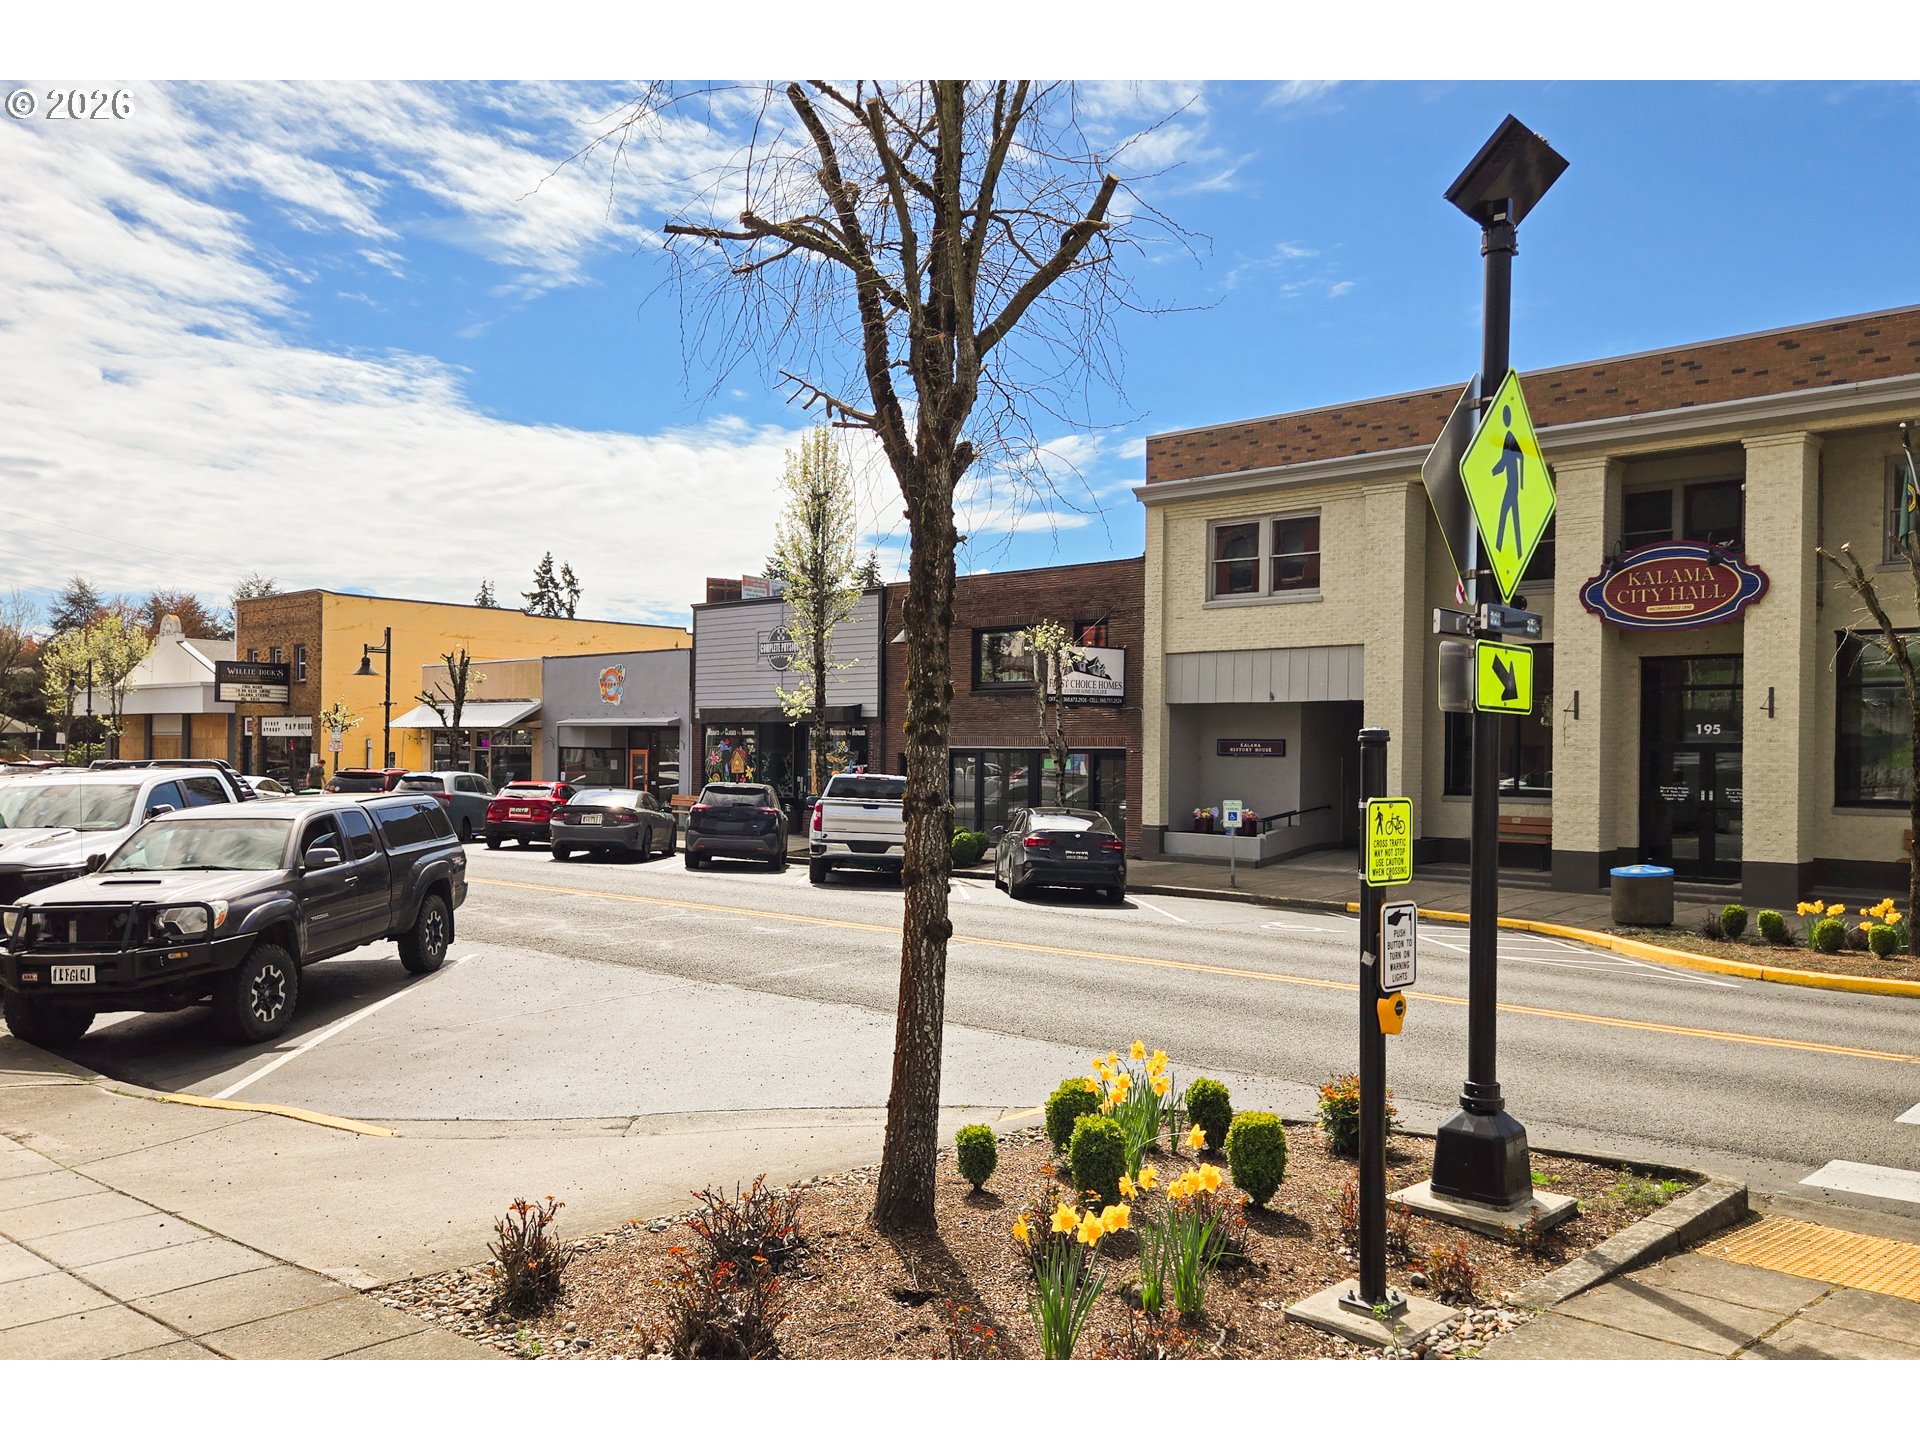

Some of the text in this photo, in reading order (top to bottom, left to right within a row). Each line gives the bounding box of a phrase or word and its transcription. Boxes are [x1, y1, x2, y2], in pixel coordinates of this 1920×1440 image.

[1628, 567, 1715, 587] KALAMA
[1617, 583, 1726, 604] CITY HALL
[1648, 604, 1682, 612] INCORPORATED
[760, 643, 781, 653] COMPLETE
[227, 667, 256, 675] WILLIE
[1070, 680, 1098, 690] CHOICE
[1098, 681, 1123, 691] HOMES
[1695, 724, 1721, 735] 195
[1374, 838, 1407, 848] CROSS TRAFFIC
[1374, 848, 1406, 857] MAY NOT STOP
[1376, 858, 1404, 866] USE CAUTION
[1372, 866, 1407, 876] WHEN CROSSING
[1394, 929, 1406, 938] PUSH
[1387, 939, 1412, 950] BUTTON TO
[1389, 950, 1410, 960] TURN ON
[1390, 961, 1410, 971] WARNING
[1392, 972, 1408, 982] LIGHTS
